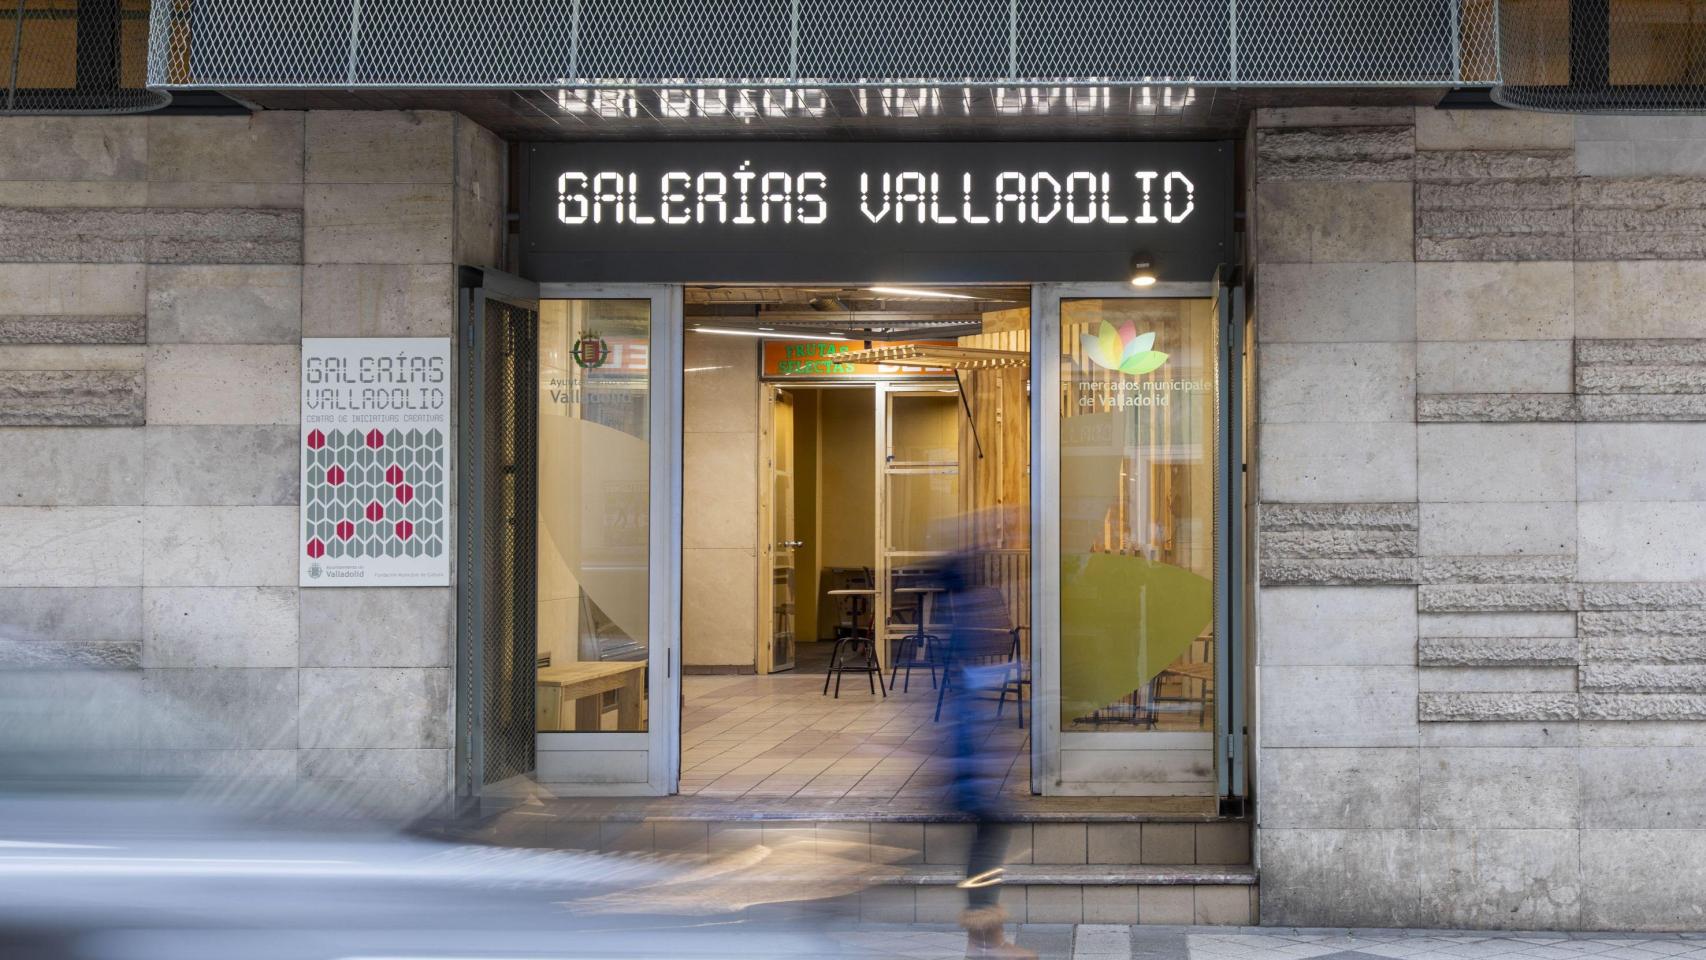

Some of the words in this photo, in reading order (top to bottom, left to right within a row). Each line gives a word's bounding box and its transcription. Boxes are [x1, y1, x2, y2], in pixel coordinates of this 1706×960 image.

[558, 160, 827, 224] GALERÍAS
[860, 171, 1194, 224] VALLADOLID
[307, 351, 444, 383] GALERÍAS
[1079, 379, 1139, 391] mercados
[307, 388, 444, 410] VALLADOLID
[1079, 395, 1094, 407] de
[1099, 394, 1168, 407] Valladolid
[306, 414, 335, 423] CENTRO
[338, 414, 348, 423] DE
[352, 414, 400, 423] INICIATIVAS
[403, 413, 444, 422] CREATIVAS
[326, 570, 364, 578] Valladolid
